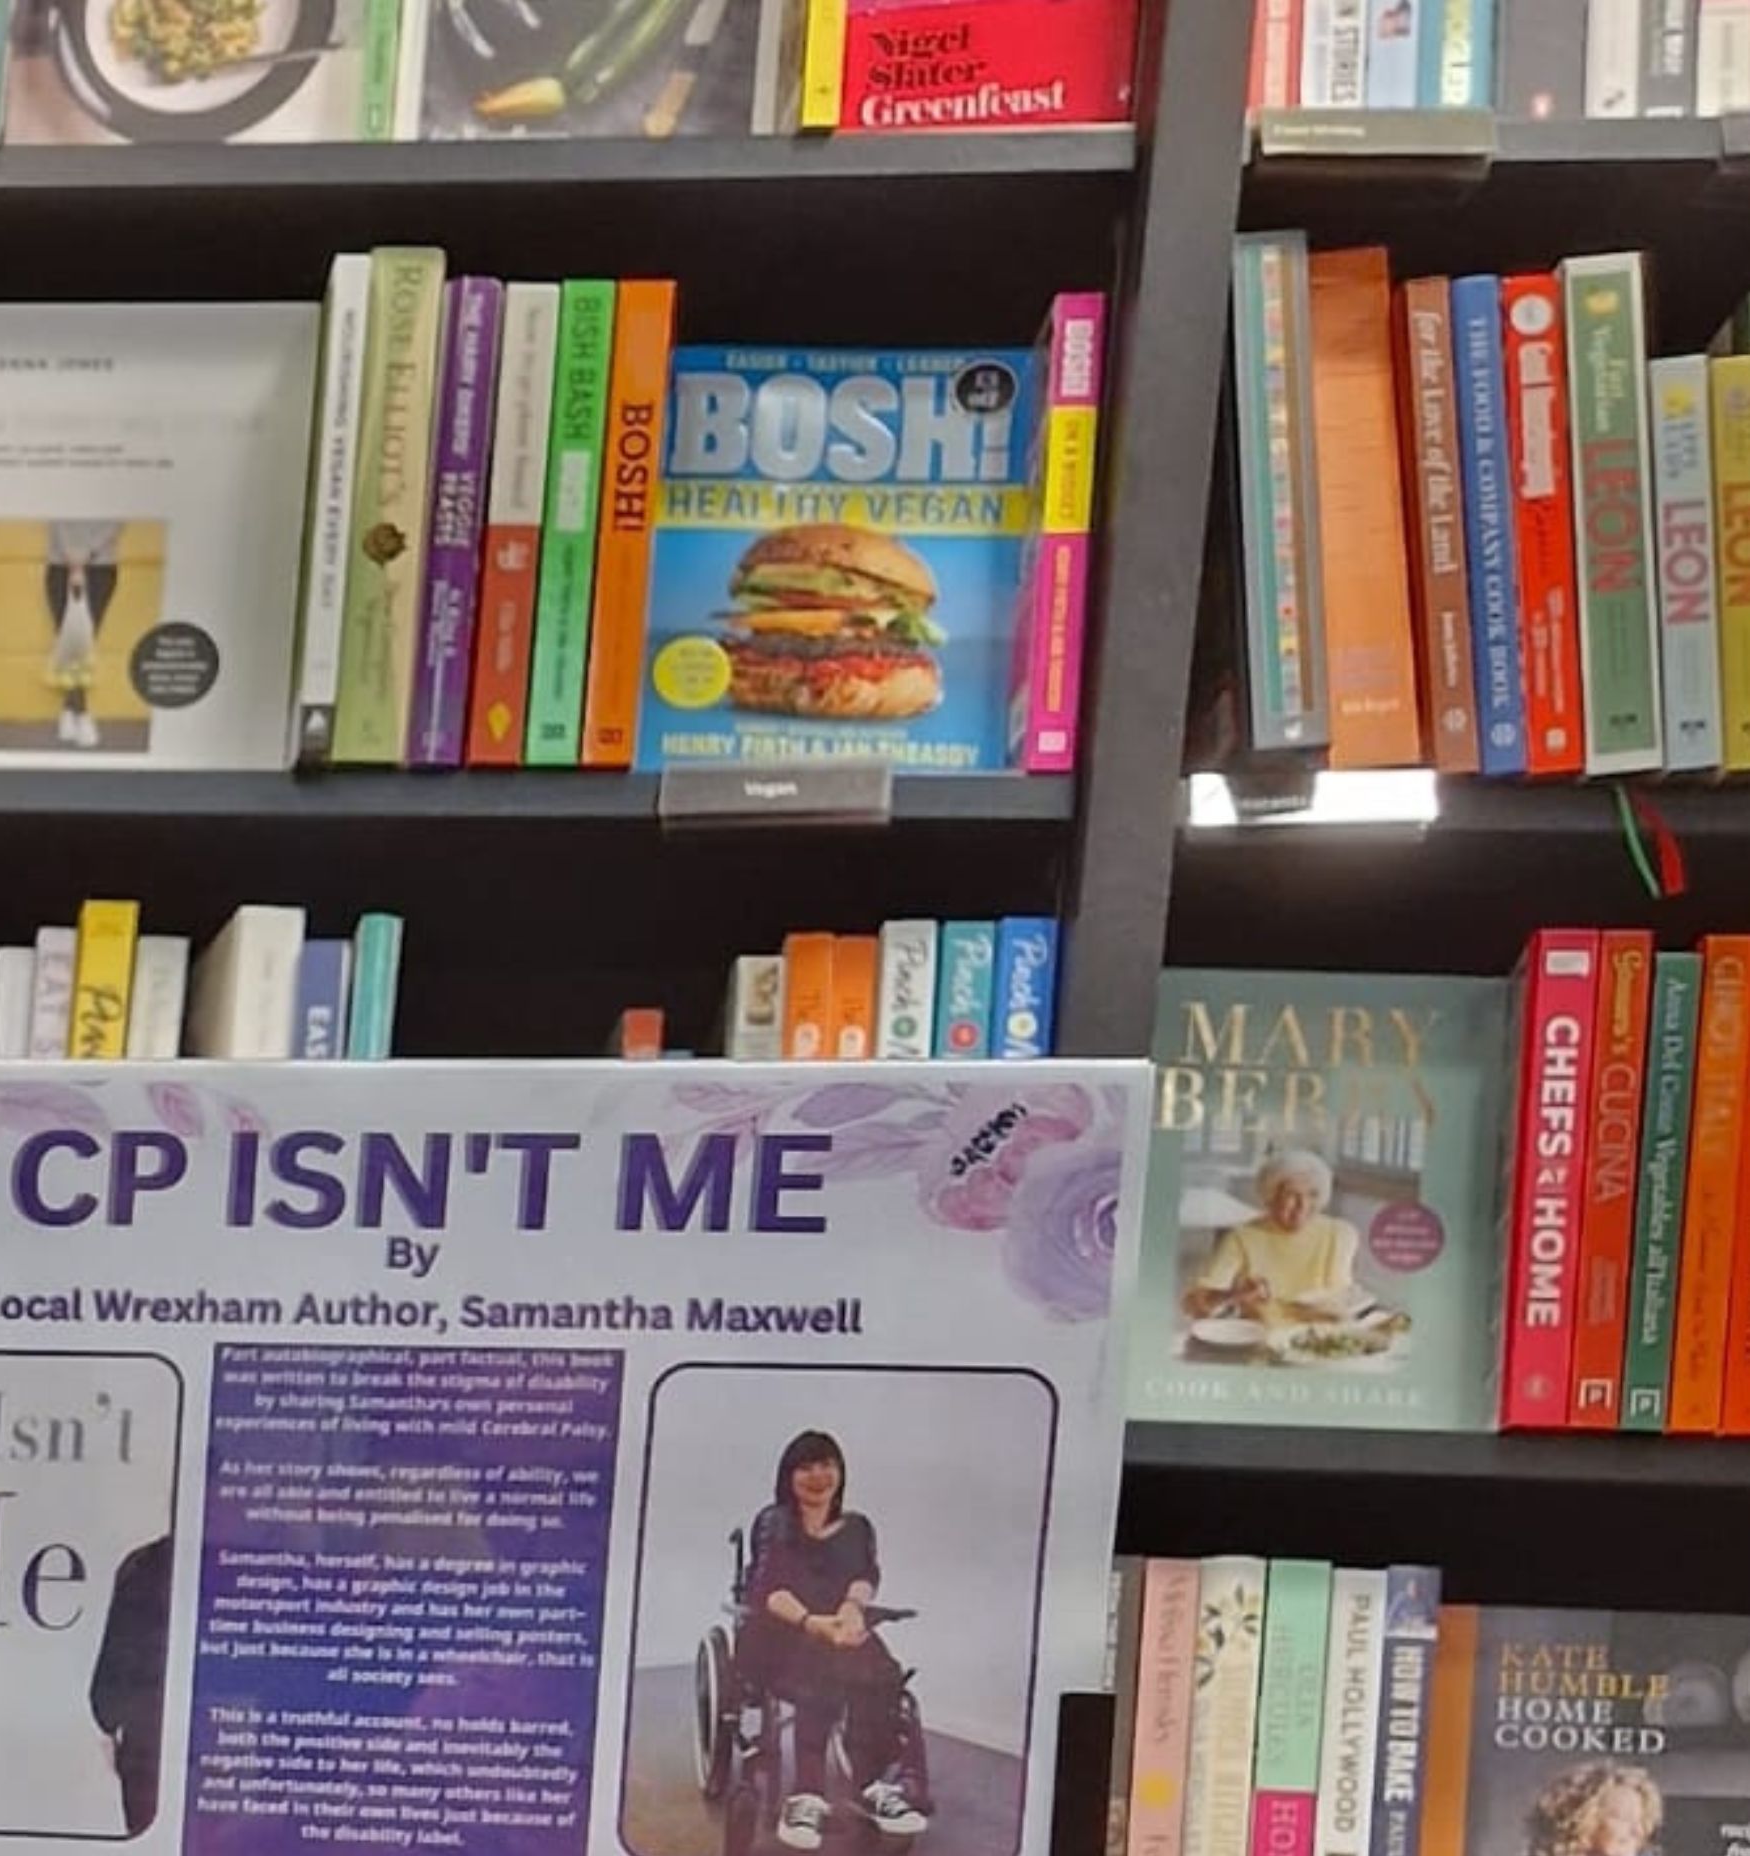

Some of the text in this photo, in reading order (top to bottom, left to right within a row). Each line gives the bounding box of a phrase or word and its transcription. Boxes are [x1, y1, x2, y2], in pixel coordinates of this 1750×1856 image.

[860, 80, 1066, 127] Greenfeast
[868, 57, 986, 88] Slater
[575, 295, 603, 361] BISH
[667, 372, 1015, 486] BOSH!
[612, 400, 654, 534] BOSH!
[665, 487, 1006, 527] HEALTHY VEGAN
[1583, 438, 1642, 594] LEON
[1661, 499, 1709, 627] LEON
[1178, 1002, 1442, 1070] MARY
[1157, 1067, 1437, 1132] BERRY
[1537, 1015, 1581, 1156] CHEFS
[1595, 1062, 1638, 1203] CUCINA
[9, 1128, 834, 1234] CP ISN'T ME
[385, 1237, 440, 1276] By
[1527, 1196, 1567, 1328] HOME
[92, 1289, 283, 1325] Wrexham
[293, 1292, 448, 1333] Author,
[459, 1296, 673, 1332] Samantha
[685, 1299, 864, 1335] Maxwell
[1345, 1592, 1373, 1660] PAUL
[1498, 1642, 1610, 1670] KATE
[1390, 1644, 1425, 1705] HOW
[1497, 1669, 1672, 1699] HUMBLE
[1389, 1706, 1420, 1738] TO
[1493, 1725, 1668, 1756] COOKED
[1494, 1697, 1615, 1727] HOME
[1334, 1667, 1368, 1836] HOLLYWOOD
[1384, 1740, 1418, 1803] BAKE
